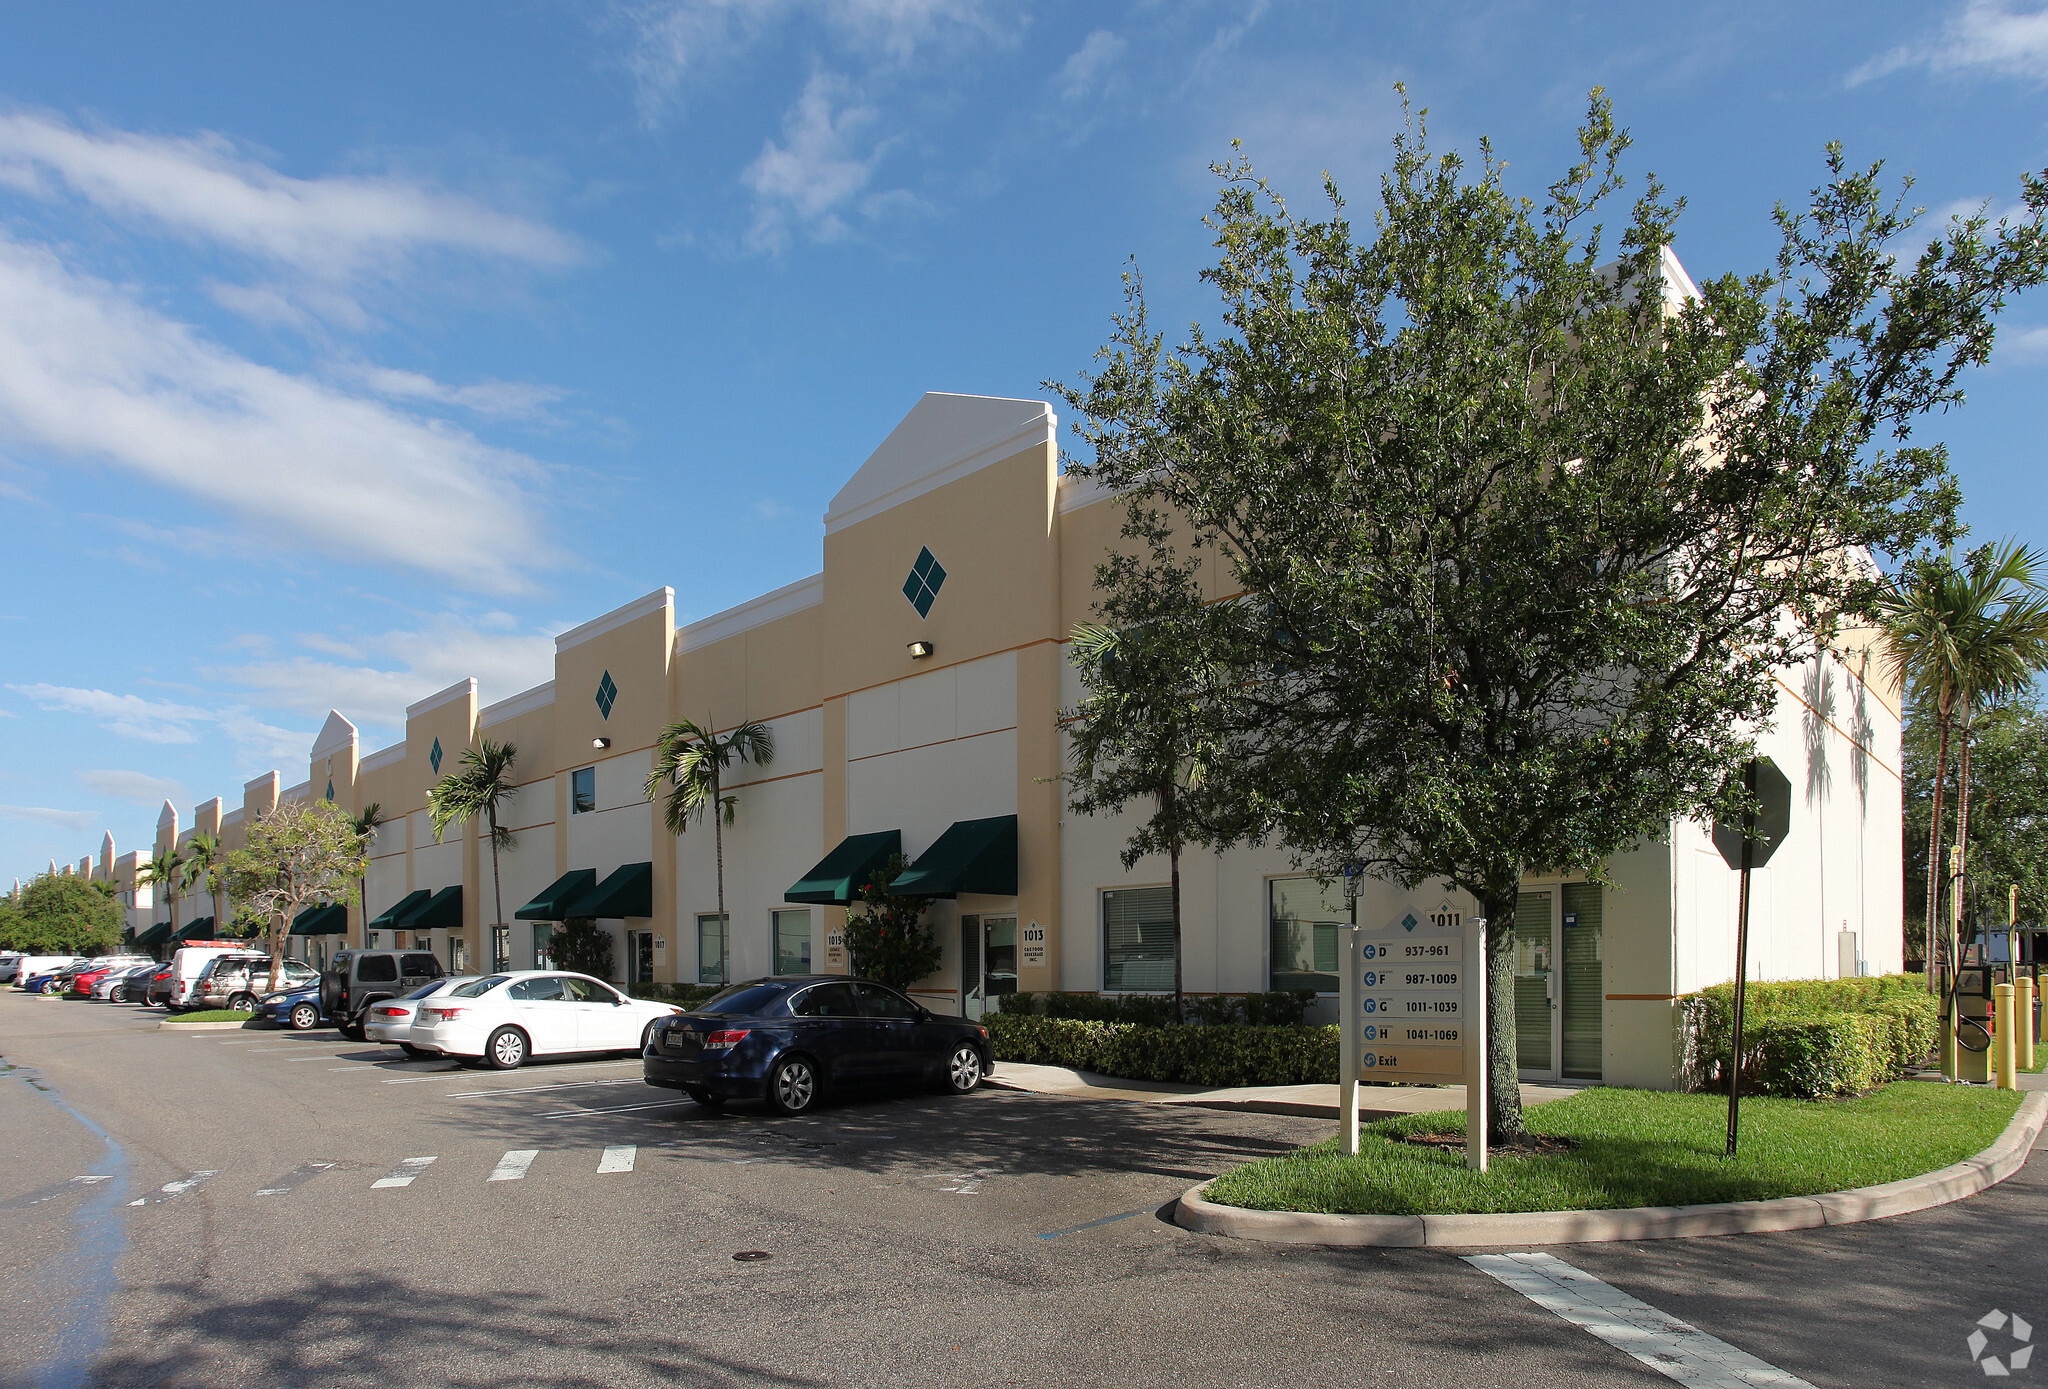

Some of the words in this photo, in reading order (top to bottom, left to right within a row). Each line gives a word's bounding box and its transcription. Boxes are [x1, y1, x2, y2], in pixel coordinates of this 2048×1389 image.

[828, 935, 842, 945] 1015
[1024, 930, 1043, 941] 1013
[1379, 947, 1387, 957] D
[1405, 945, 1449, 956] 937-961
[1379, 974, 1386, 984] F
[1405, 973, 1457, 984] 987-1009
[1379, 1001, 1387, 1012] G
[1406, 1001, 1458, 1012] 1011-1039
[1379, 1029, 1388, 1039] H
[1406, 1029, 1458, 1040] 1041-1069
[1378, 1055, 1397, 1067] Exit
